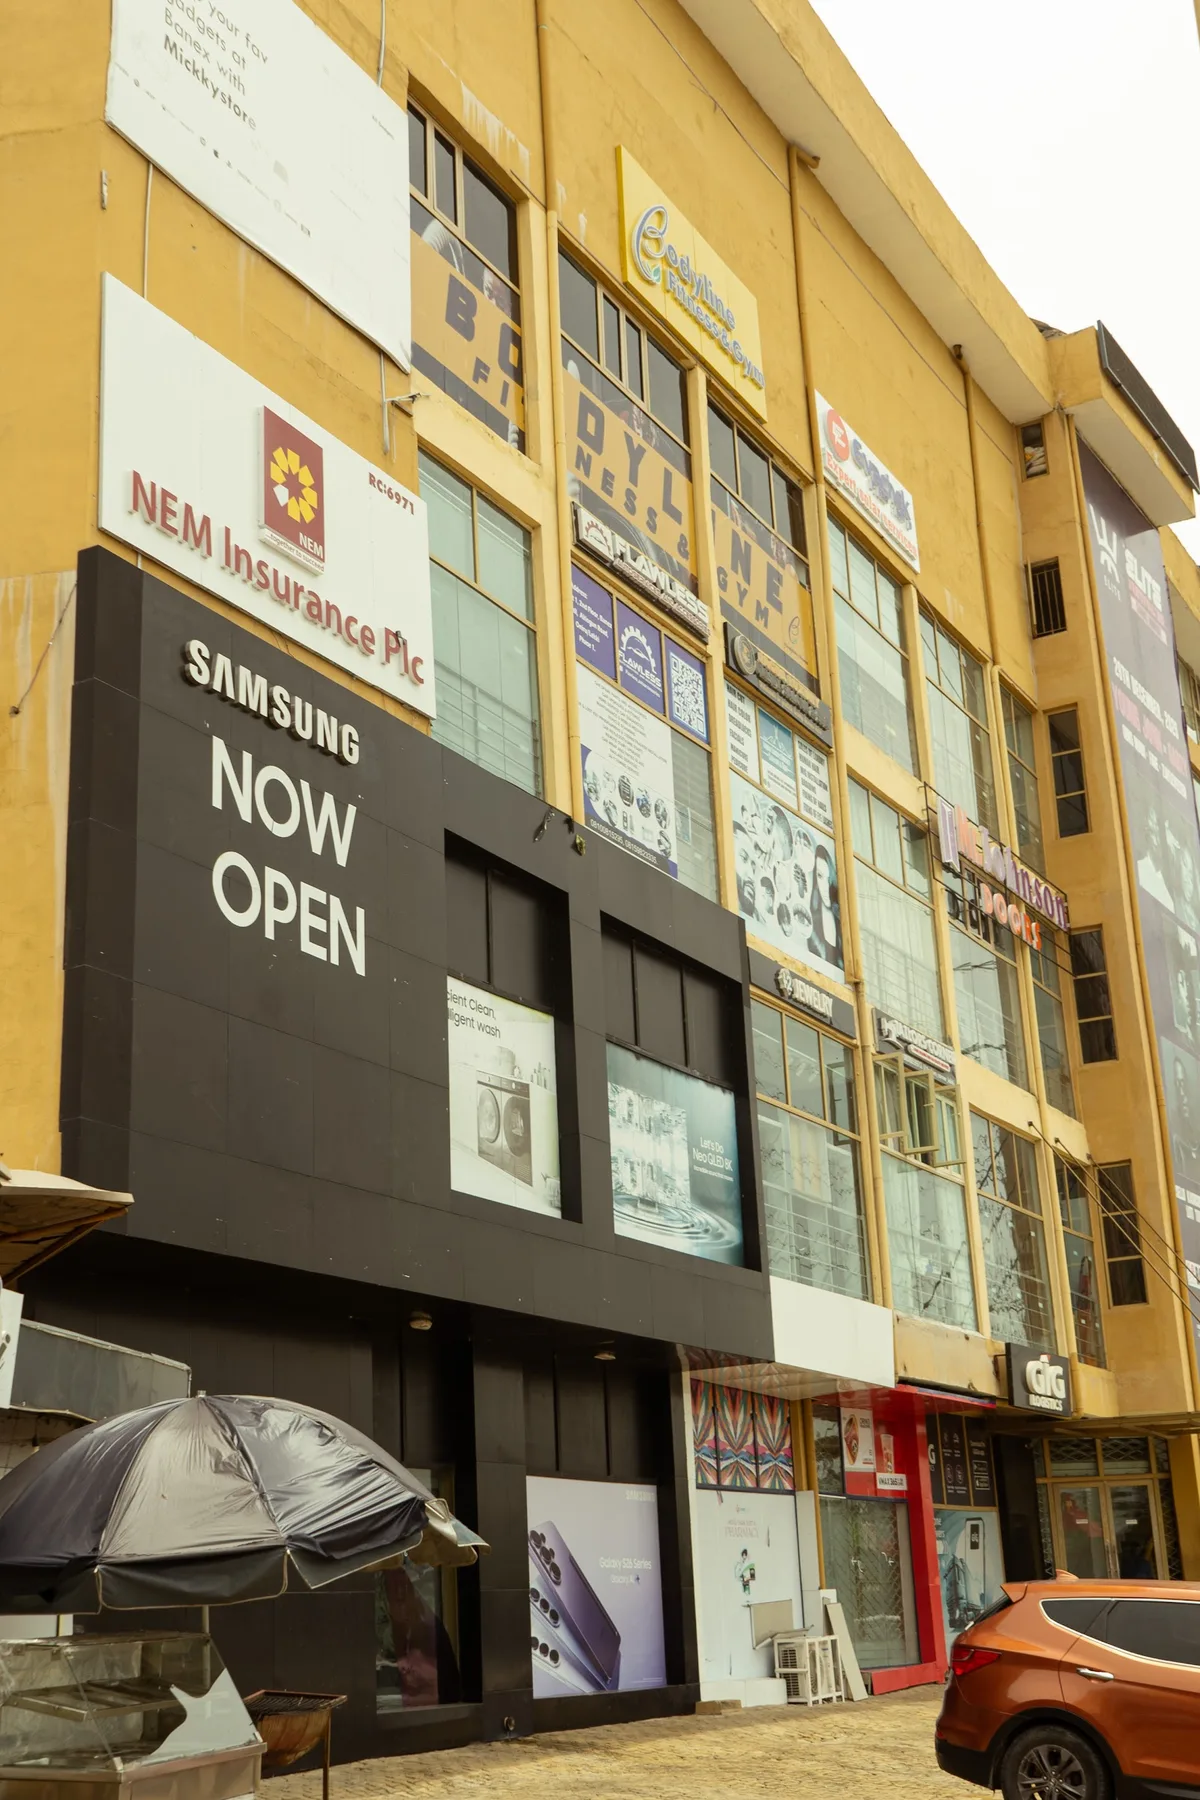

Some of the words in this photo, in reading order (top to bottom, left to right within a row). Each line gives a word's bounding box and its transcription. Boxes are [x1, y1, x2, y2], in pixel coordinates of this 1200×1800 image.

[165, 8, 210, 63] Banex
[217, 60, 246, 96] with
[208, 1, 240, 37] your
[245, 33, 269, 63] fav
[231, 50, 247, 70] at
[163, 34, 256, 130] Mickkystore
[665, 268, 721, 340] Fitness
[718, 331, 731, 354] &
[731, 340, 766, 389] Gym
[368, 472, 415, 516] RC:6971
[131, 469, 213, 558] NEM
[222, 525, 376, 656] Insurance
[383, 626, 425, 685] Plc
[299, 532, 324, 560] NEM
[614, 533, 710, 623] FLAWLESS
[1124, 548, 1162, 613] ELITE
[186, 638, 361, 766] SAMSUNG
[211, 734, 358, 868] NOW
[211, 850, 367, 977] OPEN
[476, 1020, 501, 1039] wash
[792, 978, 834, 1020] JEWELRY
[692, 1147, 708, 1163] Neo
[1029, 1394, 1064, 1412] LOGISTICS
[625, 1489, 656, 1502] SAMSUNG
[599, 1556, 622, 1571] Galaxy
[633, 1557, 652, 1569] Series
